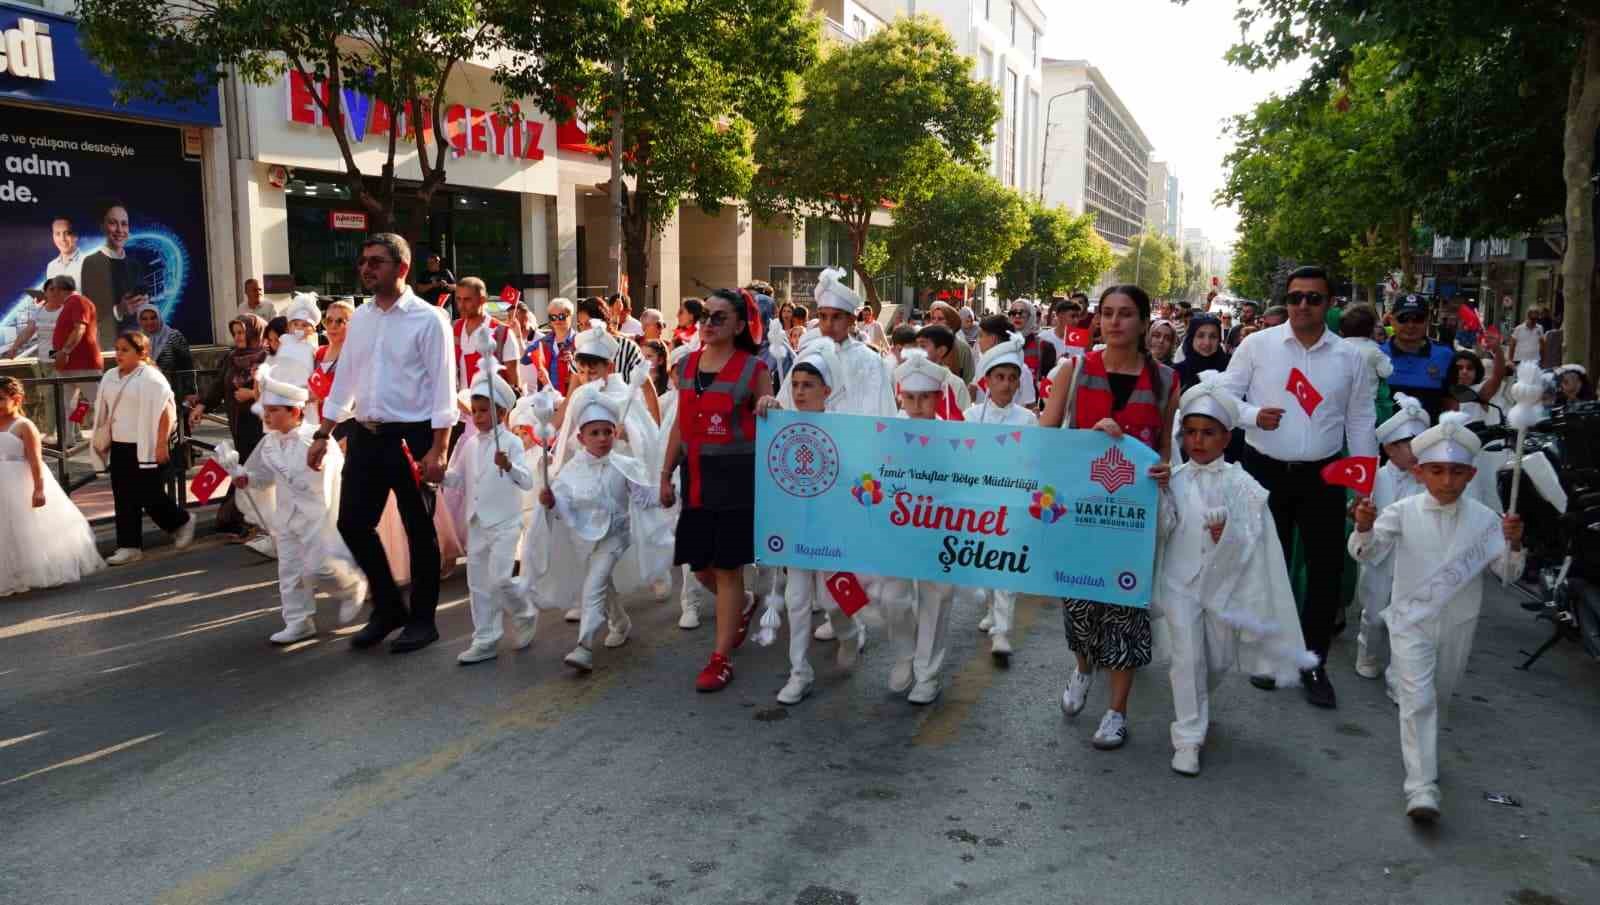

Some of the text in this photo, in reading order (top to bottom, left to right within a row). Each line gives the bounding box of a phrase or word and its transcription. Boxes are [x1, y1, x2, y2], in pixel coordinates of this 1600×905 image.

[443, 101, 544, 161] ÇEYİZ
[11, 135, 26, 144] ve
[29, 136, 79, 151] çalışana
[81, 141, 135, 157] desteğiyle
[5, 153, 71, 177] adım
[0, 180, 38, 203] de.
[879, 464, 1039, 492] İzmir Vakıflar Bölge Müdürlüğü
[889, 491, 1009, 536] Sünnet
[1074, 502, 1146, 520] VAKIFLAR
[938, 535, 1031, 573] Şöleni
